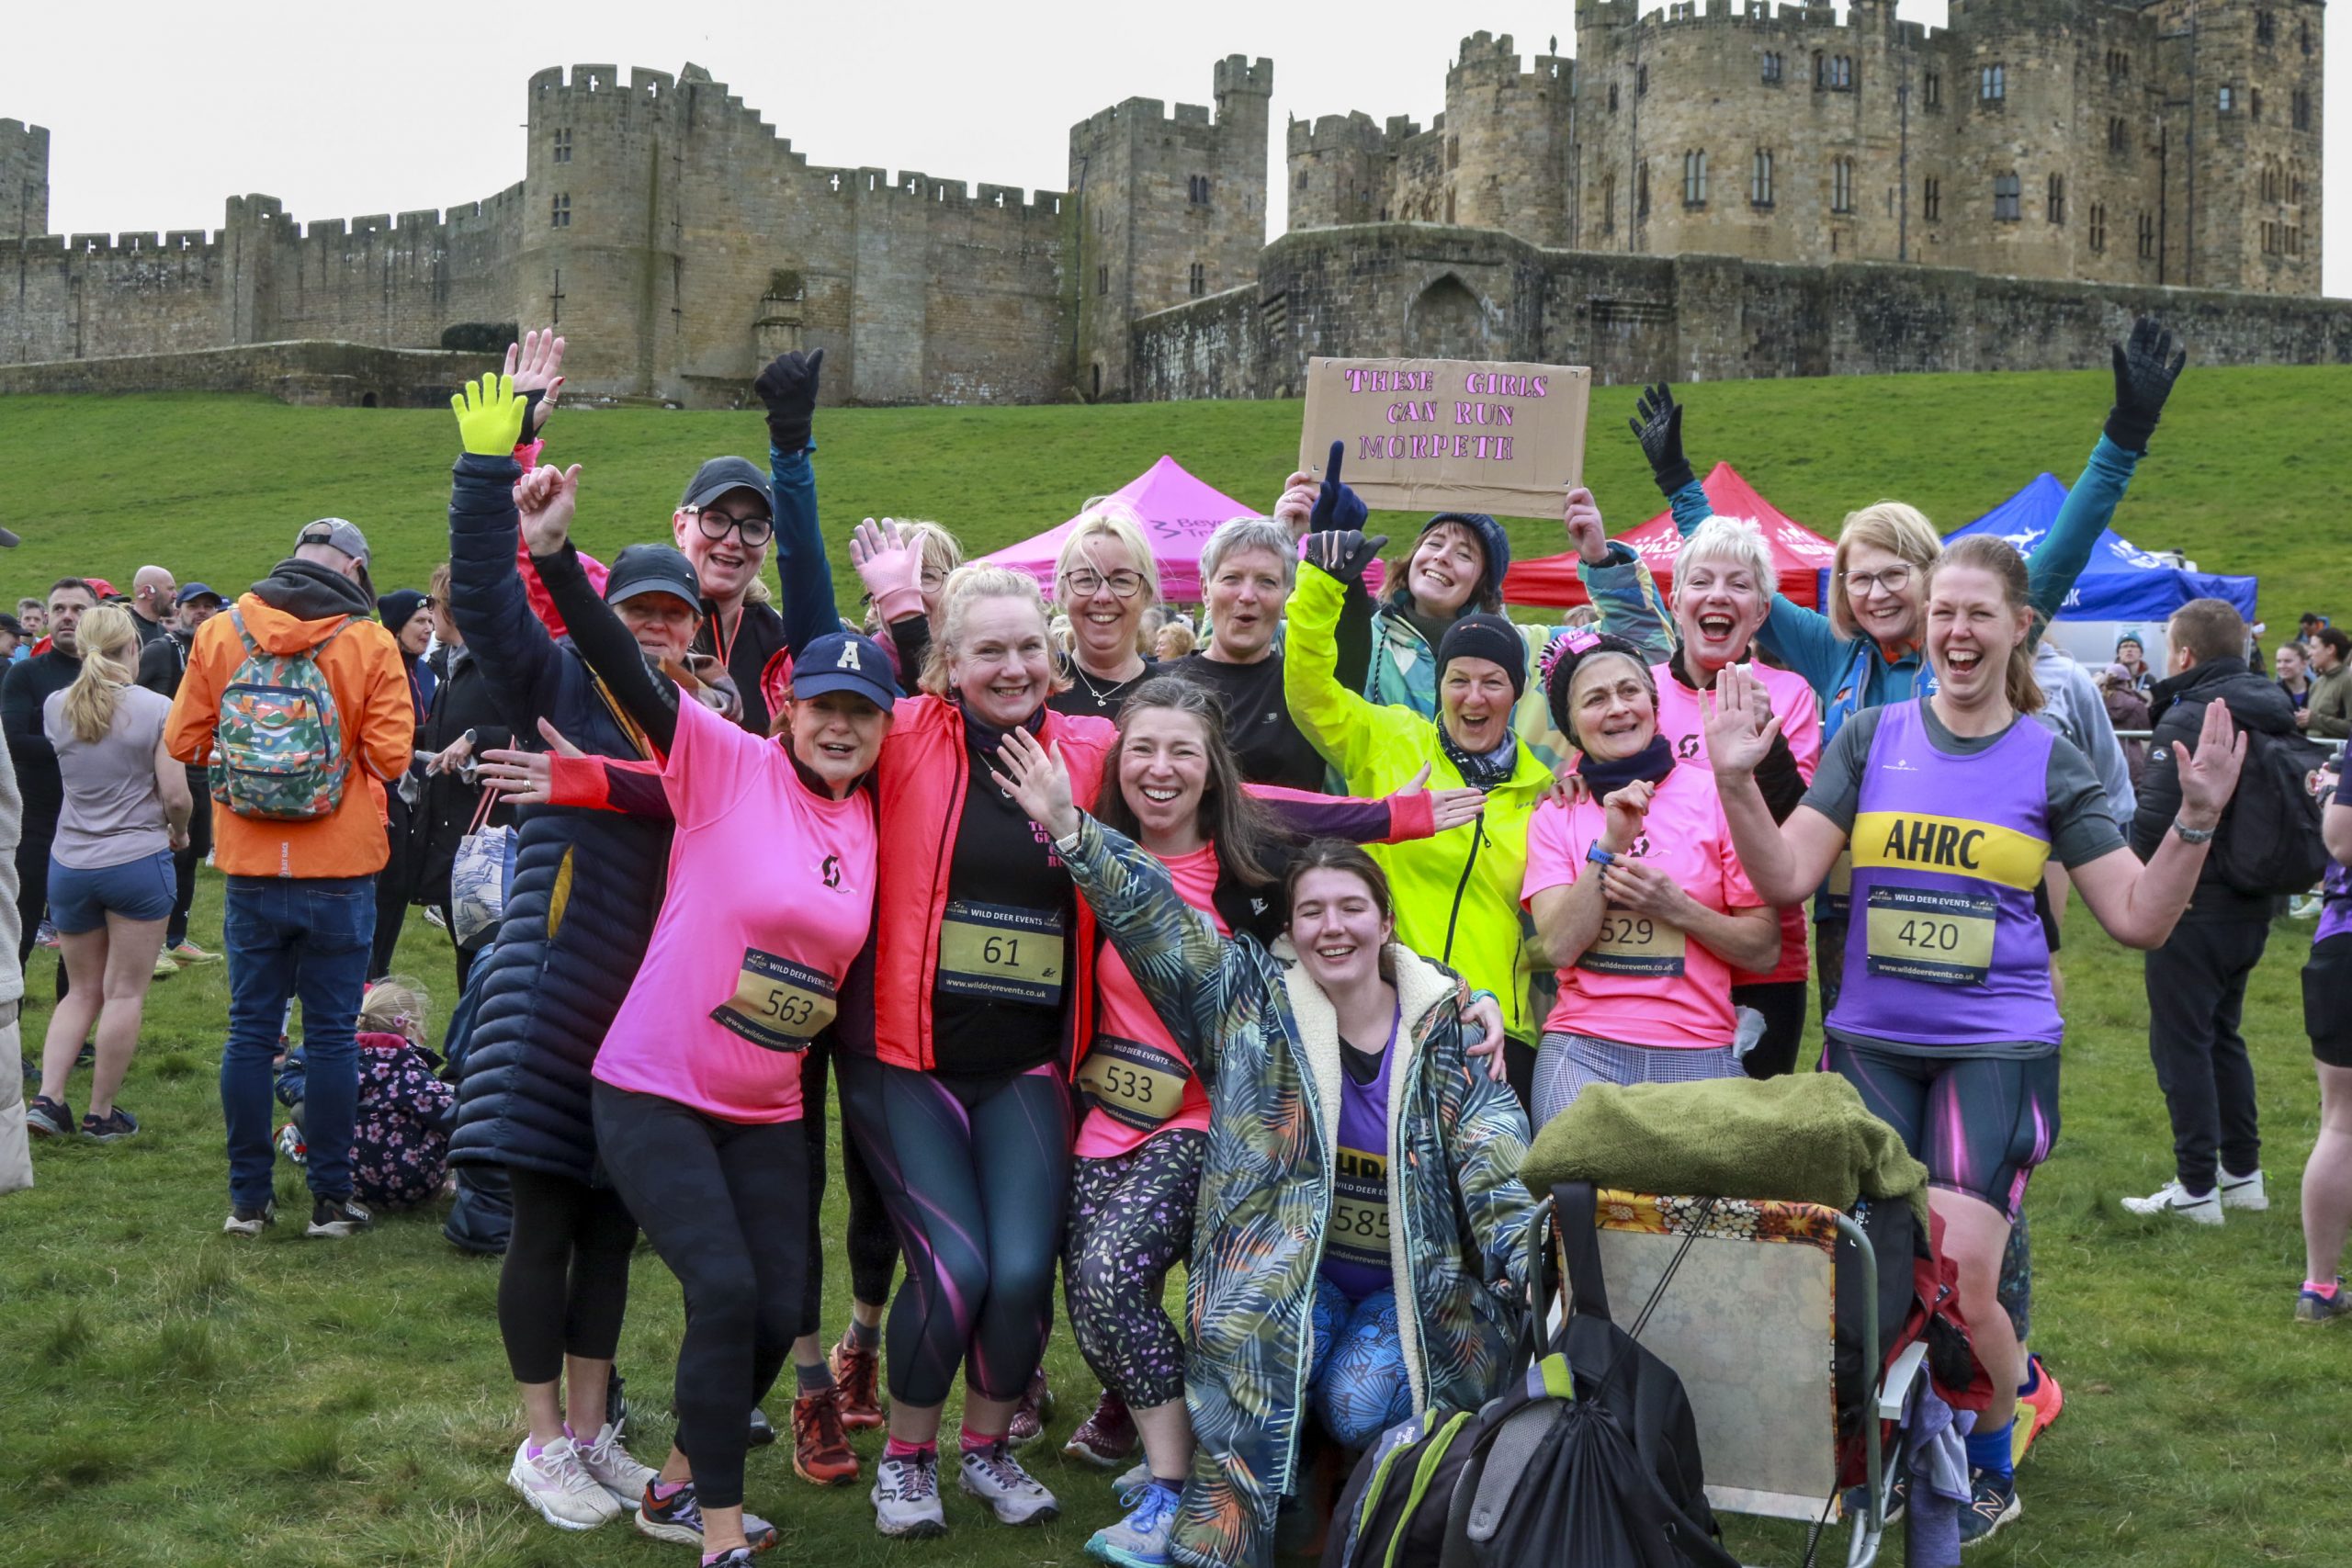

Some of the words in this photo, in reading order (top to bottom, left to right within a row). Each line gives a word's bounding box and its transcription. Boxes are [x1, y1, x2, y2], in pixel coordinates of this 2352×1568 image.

[1345, 369, 1433, 393] THESE
[1465, 372, 1548, 398] GIRLS
[1386, 401, 1437, 424] CAN
[1454, 401, 1514, 426] RUN
[1359, 434, 1514, 460] MORPETH
[836, 640, 861, 671] A
[1883, 818, 1985, 870] AHRC
[1894, 893, 1916, 903] WILD
[1917, 895, 1938, 905] DEER
[1939, 897, 1970, 908] EVENTS
[970, 908, 992, 919] WILD
[993, 912, 1014, 922] DEER
[1015, 915, 1043, 926] EVENTS
[1898, 919, 1959, 951] 420
[983, 936, 1020, 967] 61
[769, 962, 789, 975] WILD
[789, 968, 808, 981] DEER
[807, 975, 826, 988] EVENTS
[945, 978, 1046, 998] www.wilddeerevents.co.uk
[762, 988, 814, 1026] 563
[1113, 1043, 1127, 1053] WILD
[1127, 1046, 1142, 1057] DEER
[1141, 1052, 1170, 1066] EVENTS
[1103, 1066, 1153, 1103] 533
[1355, 1185, 1377, 1195] DEER
[1334, 1204, 1391, 1239] 585
